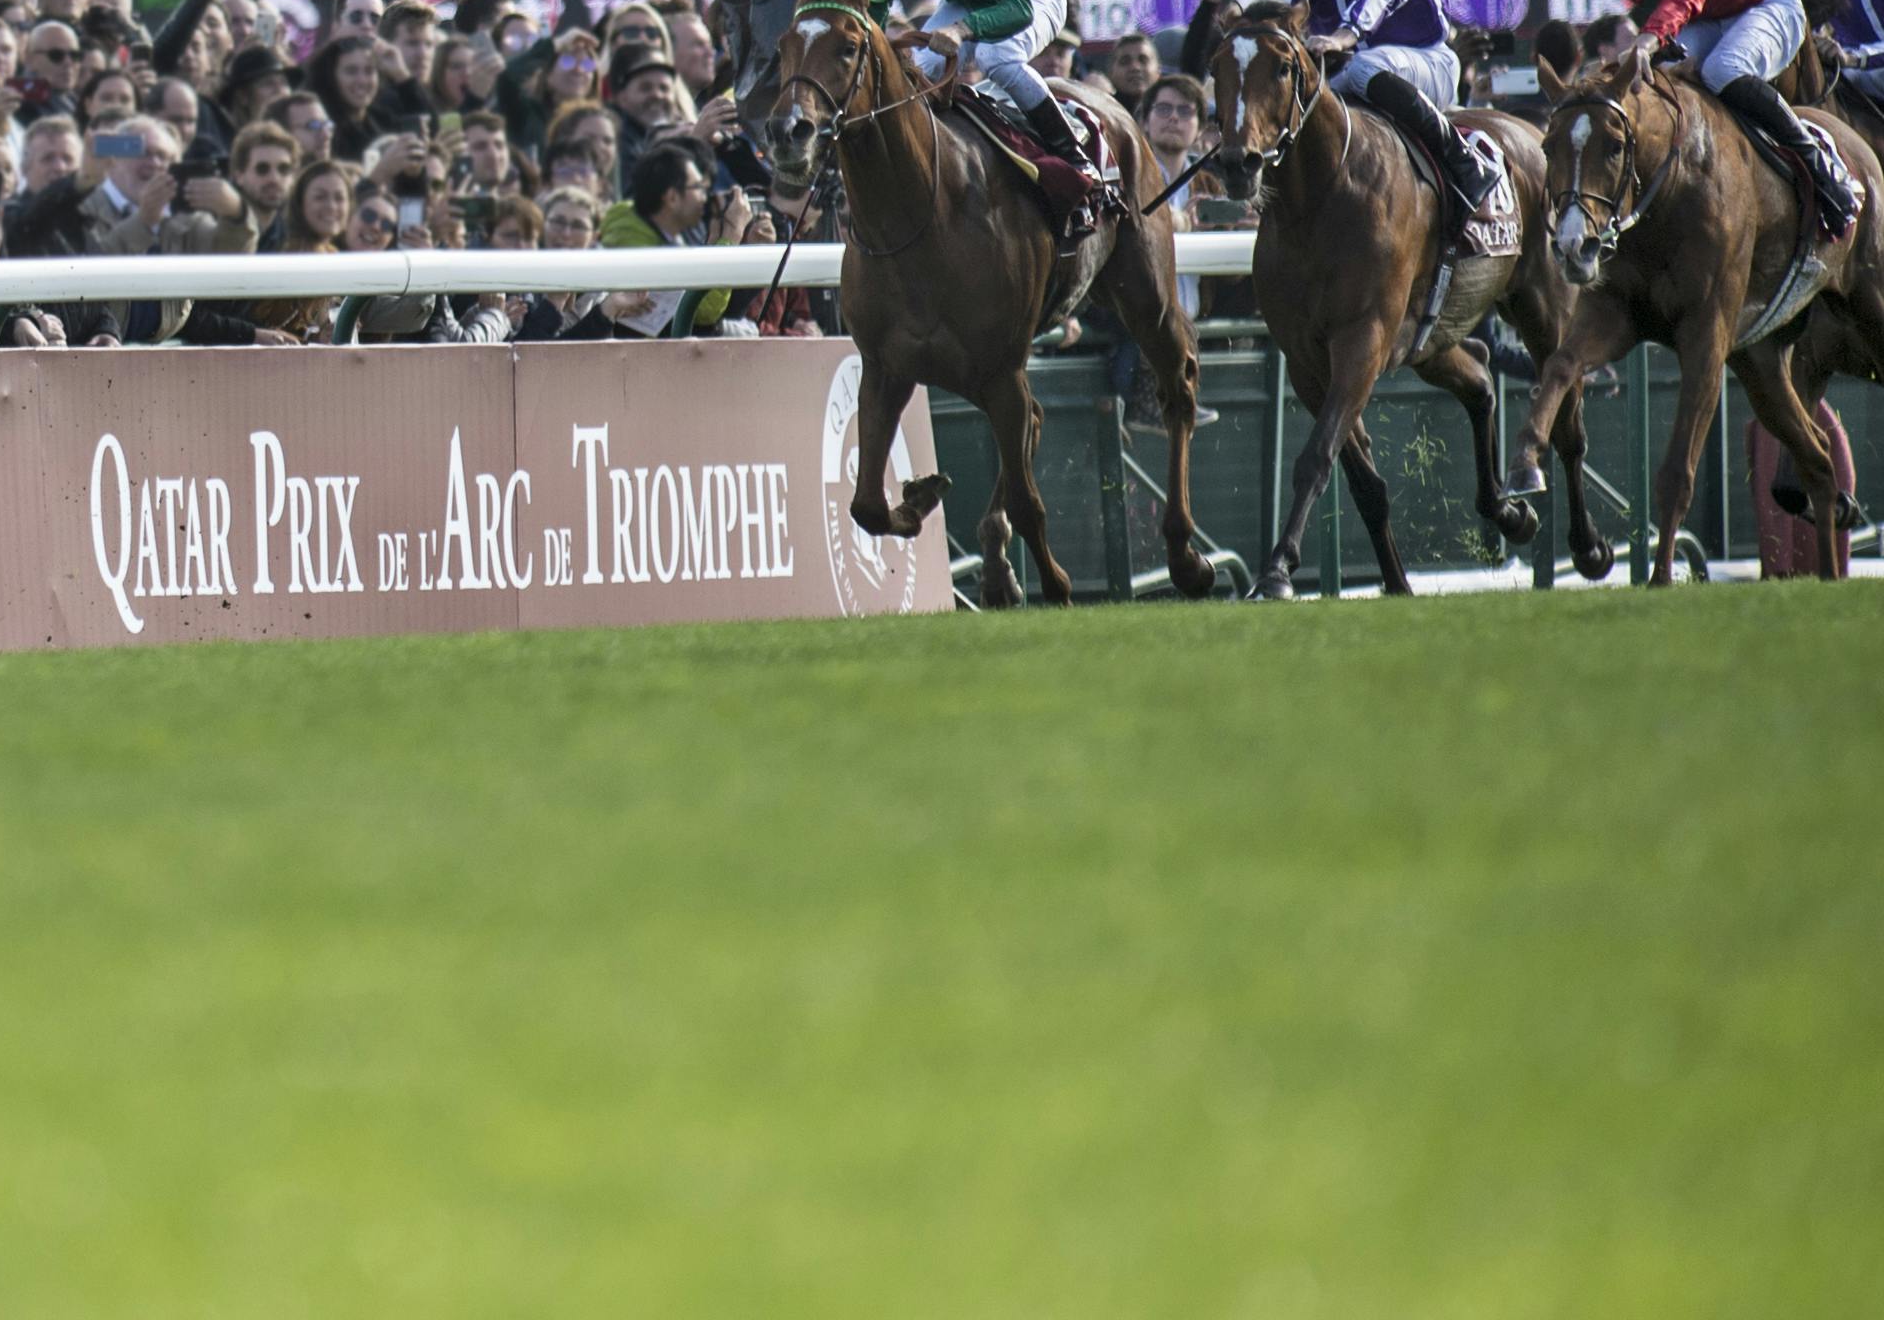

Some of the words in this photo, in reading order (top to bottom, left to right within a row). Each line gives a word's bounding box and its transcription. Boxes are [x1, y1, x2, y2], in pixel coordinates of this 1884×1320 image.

[829, 364, 862, 436] QAT
[90, 432, 238, 634] QATAR
[249, 430, 365, 594] PRIX
[377, 532, 410, 592] DE
[418, 425, 534, 590] L'ARC
[543, 527, 574, 587] DE
[571, 421, 795, 584] TRIOMPHE
